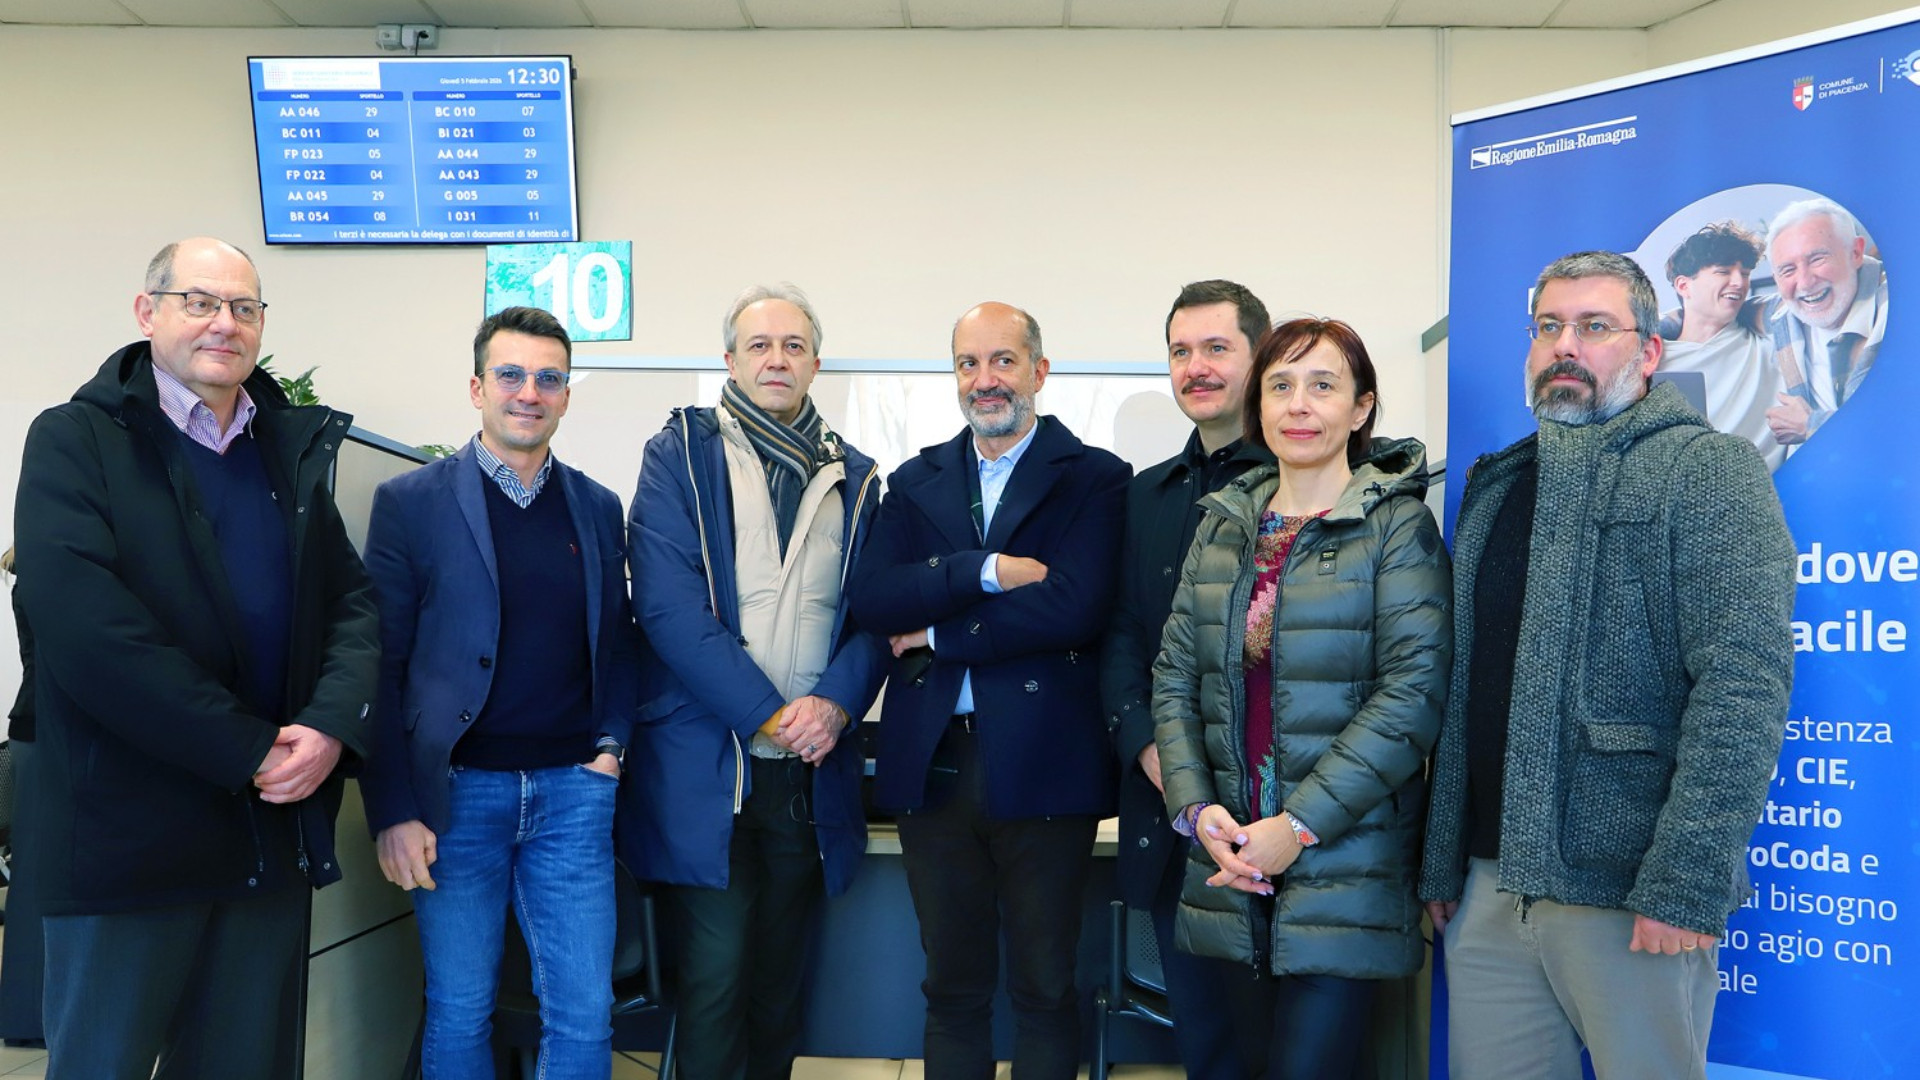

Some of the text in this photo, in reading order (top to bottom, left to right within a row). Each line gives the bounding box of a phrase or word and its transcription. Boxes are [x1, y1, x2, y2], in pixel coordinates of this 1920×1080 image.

[507, 68, 560, 84] 12:30
[1818, 76, 1855, 90] COMUNE
[1828, 82, 1869, 96] PIACENZA
[280, 107, 320, 117] AA 046
[365, 107, 378, 117] 29
[435, 107, 476, 117] BC 010
[522, 107, 534, 117] 07
[282, 128, 321, 138] BC 011
[367, 128, 379, 138] 04
[438, 128, 474, 138] BI 021
[523, 128, 535, 138] 03
[284, 149, 324, 159] FP 023
[368, 149, 381, 159] 05
[437, 149, 479, 159] AA 044
[524, 149, 537, 159] 29
[286, 170, 326, 180] FP 022
[370, 170, 383, 180] 04
[439, 170, 480, 180] AA 043
[526, 170, 538, 180] 29
[288, 191, 328, 201] AA 045
[372, 191, 384, 201] 29
[444, 191, 478, 201] G 005
[526, 191, 539, 201] 05
[290, 212, 329, 222] BR 054
[373, 212, 386, 222] 08
[448, 212, 476, 222] I 031
[528, 212, 539, 222] 11
[339, 230, 358, 238] terzi
[360, 229, 365, 238] è
[368, 230, 409, 238] necessaria
[411, 230, 419, 238] la
[421, 230, 448, 240] delega
[472, 230, 514, 238] documenti
[533, 252, 624, 332] 10
[1796, 542, 1919, 584] dove
[1790, 610, 1907, 652] acile
[1785, 716, 1894, 744] stenza
[1796, 757, 1856, 790] CIE,
[1746, 842, 1879, 875] oCoda e
[1770, 883, 1897, 925] bisogno
[1758, 930, 1823, 963] agio
[1834, 940, 1891, 966] con
[1718, 965, 1757, 994] ale
